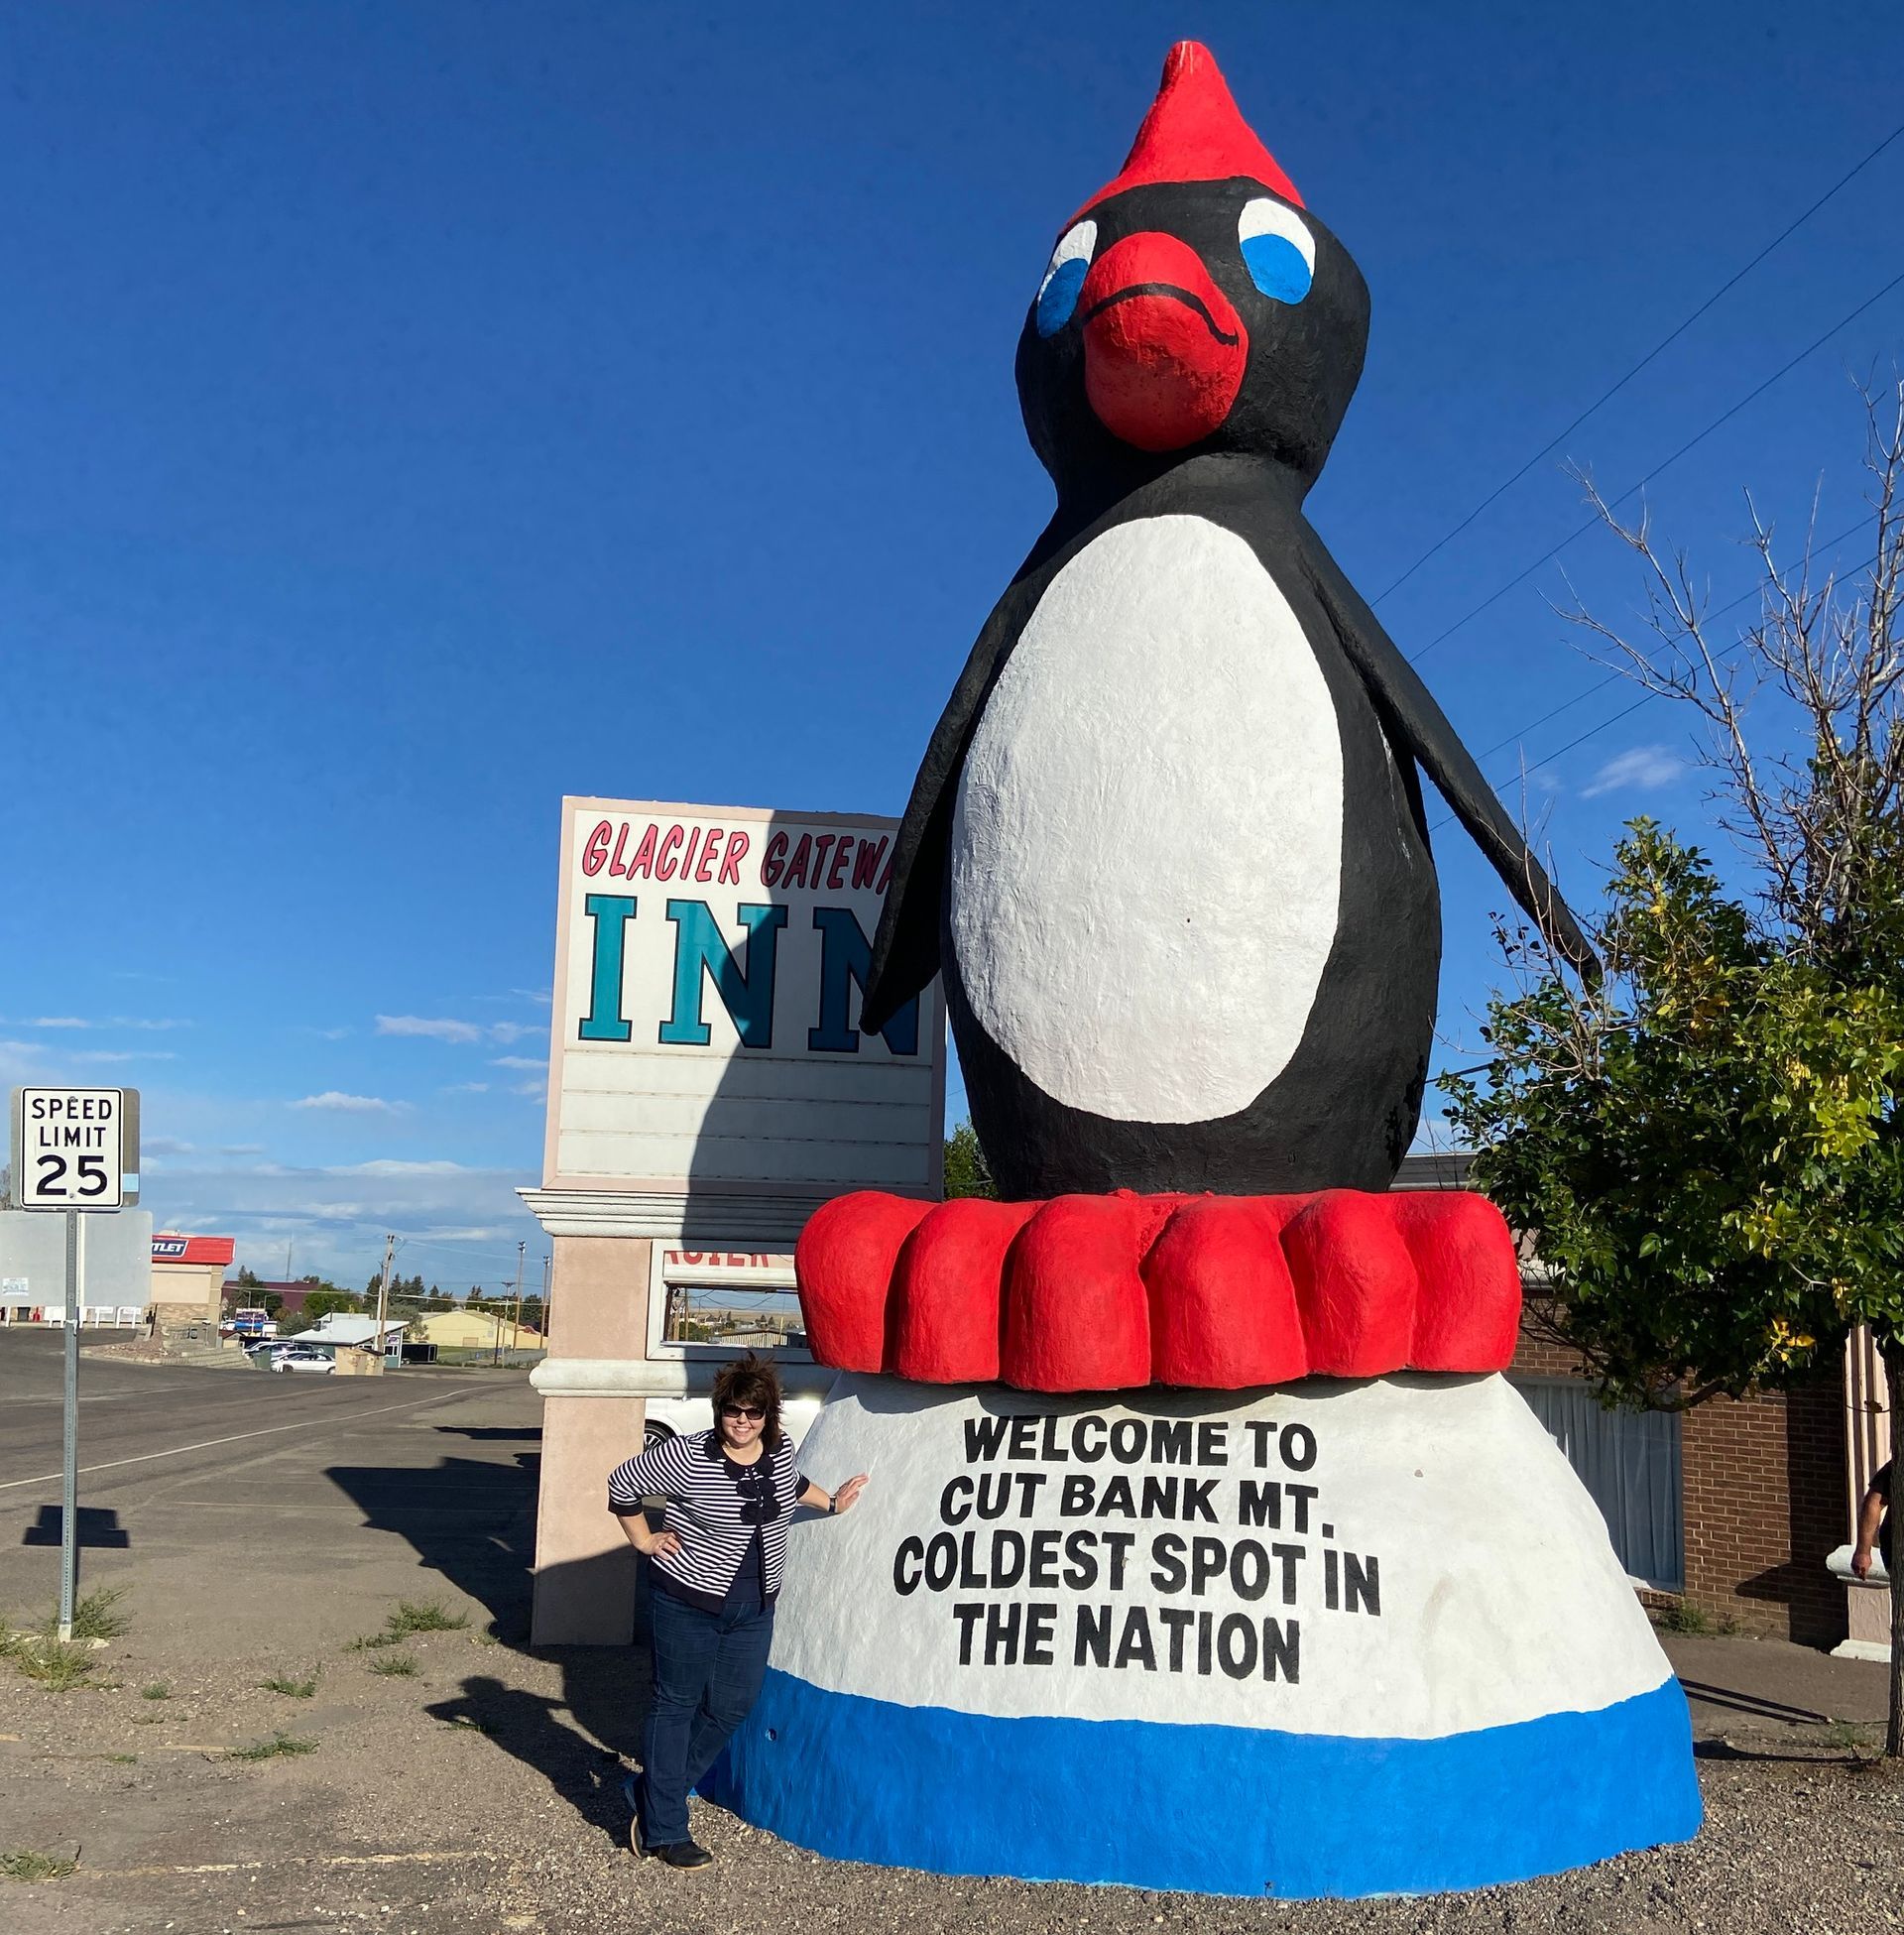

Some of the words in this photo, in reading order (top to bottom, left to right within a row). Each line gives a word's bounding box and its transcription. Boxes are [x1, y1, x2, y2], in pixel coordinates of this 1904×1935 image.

[582, 820, 750, 886] GLACIER
[578, 893, 920, 1056] INN
[32, 1098, 113, 1121] SPEED
[40, 1126, 107, 1148] LIMIT
[36, 1153, 108, 1196] 25
[963, 1414, 1229, 1467] WELCOME
[1243, 1420, 1318, 1473] TO
[940, 1472, 1047, 1526] CUT
[1060, 1475, 1221, 1524] BANK
[1238, 1480, 1335, 1538] MT.
[892, 1528, 1135, 1596] COLDEST
[1150, 1532, 1307, 1606] SPOT
[1324, 1549, 1382, 1617] IN
[953, 1602, 1057, 1666] THE
[1074, 1604, 1301, 1684] NATION
